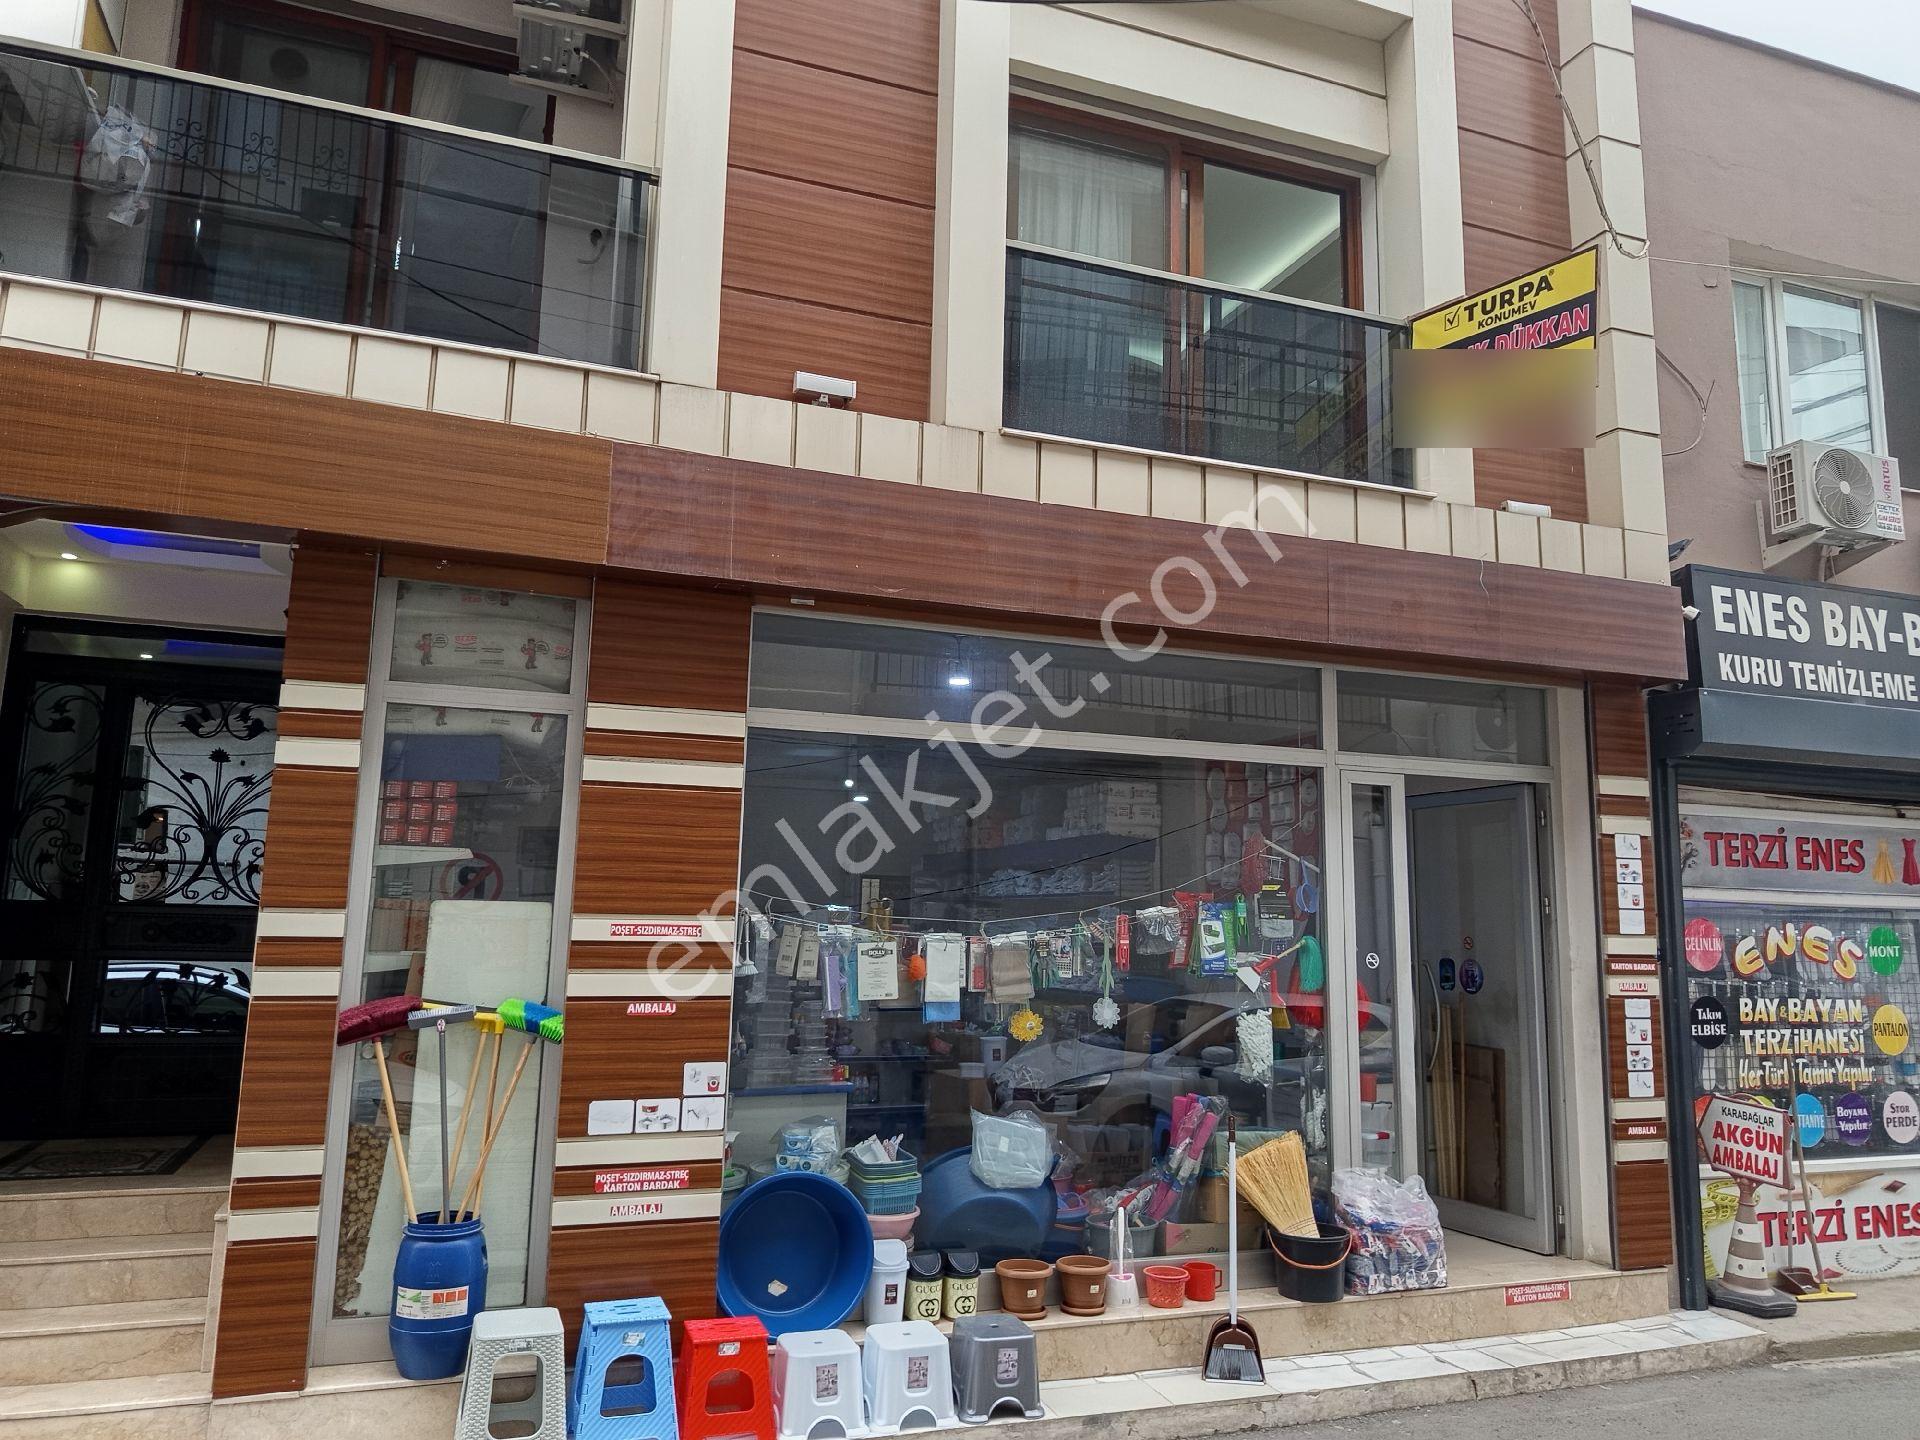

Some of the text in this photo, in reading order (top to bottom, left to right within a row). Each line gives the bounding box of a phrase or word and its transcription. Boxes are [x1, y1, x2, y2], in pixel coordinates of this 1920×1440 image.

[1464, 275, 1553, 323] TURPA
[1477, 299, 1537, 330] KONUMEV
[1711, 585, 1811, 643] ENES
[1718, 652, 1919, 702] KURU TEMİZLEME
[1704, 827, 1866, 873] TERZİ ENES
[1733, 922, 1863, 981] ENES
[1869, 945, 1900, 958] MONT
[627, 1003, 677, 1014] AMBALAJ
[1739, 998, 1780, 1024] BAY
[1787, 998, 1863, 1024] BAYAN
[1691, 1021, 1728, 1036] ELBİSE
[1873, 1021, 1908, 1037] PANTALON
[1740, 1059, 1764, 1089] Her
[1796, 1058, 1835, 1086] Tamir
[1721, 1106, 1774, 1127] KARABAĞLAR
[1797, 1110, 1825, 1129] TTANİYE
[1886, 1116, 1918, 1128] PERDE
[1628, 1126, 1657, 1135] AMBALAJ
[1712, 1120, 1783, 1156] AKGÜN
[1712, 1144, 1779, 1180] AMBALAJ
[595, 1170, 689, 1185] POŞET-SIZDIRMAZ-STREÇ
[603, 1179, 681, 1193] KARTON BARDAK
[610, 1203, 663, 1217] AMBALAJ
[1757, 1199, 1847, 1249] TERZİ
